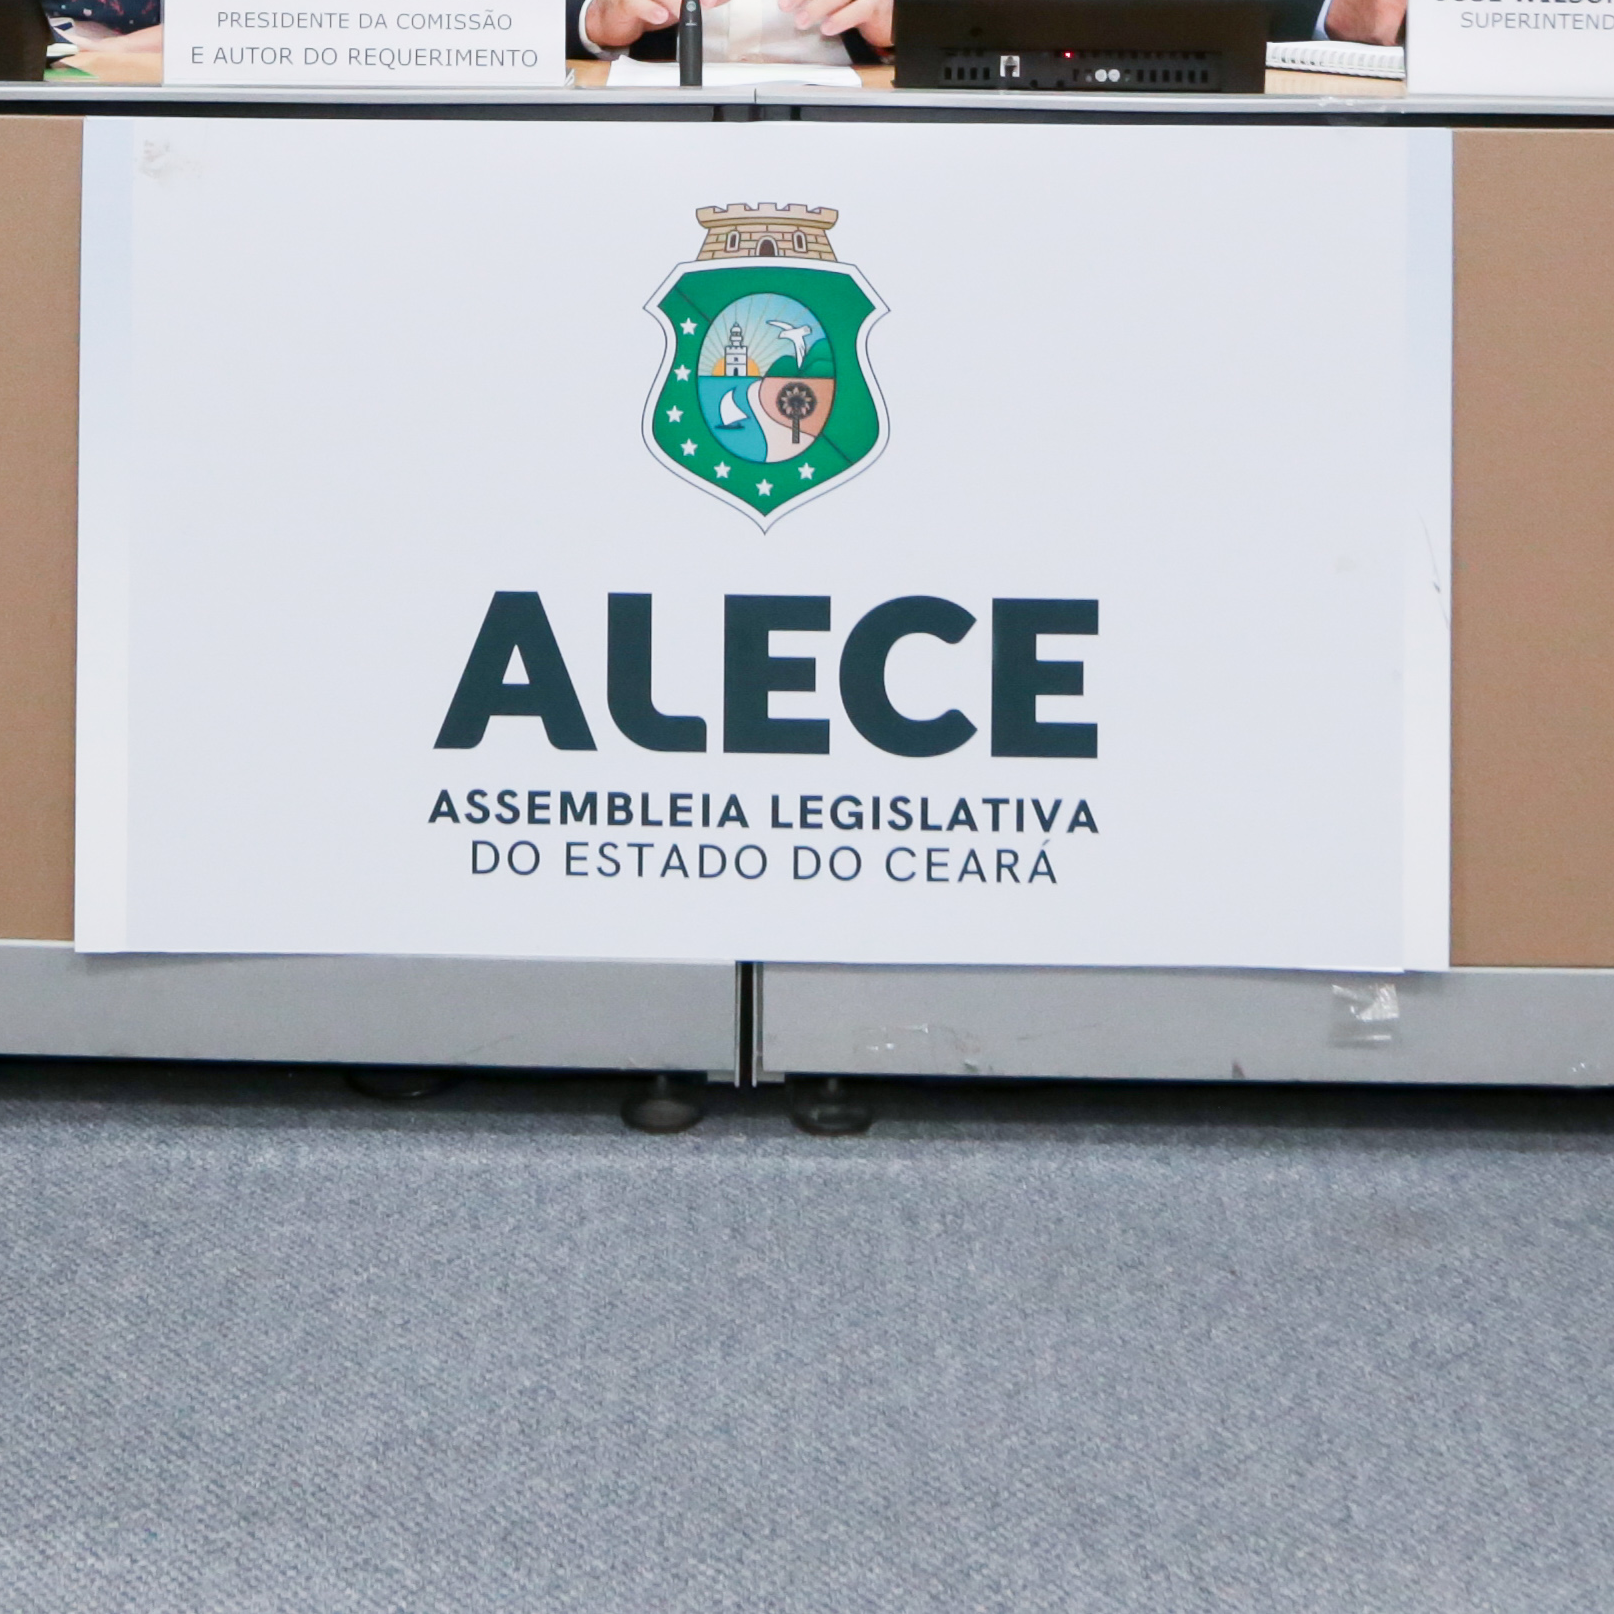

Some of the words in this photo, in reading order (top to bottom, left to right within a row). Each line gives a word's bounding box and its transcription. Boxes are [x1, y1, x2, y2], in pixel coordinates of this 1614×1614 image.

[217, 11, 350, 29] PRESIDENTE
[359, 12, 388, 30] DA
[396, 9, 513, 31] COMISSÃO
[191, 46, 204, 65] E
[212, 46, 294, 65] AUTOR
[304, 47, 338, 66] DO
[348, 47, 538, 71] REQUERIMENTO
[432, 590, 1100, 760] ALECE
[427, 788, 750, 829] ASSEMBLEIA
[770, 794, 1099, 834] LEGISLATIVA
[471, 839, 541, 876] DO
[565, 841, 768, 880] ESTADO
[792, 845, 862, 882] DO
[885, 839, 1058, 884] CEARÁ
